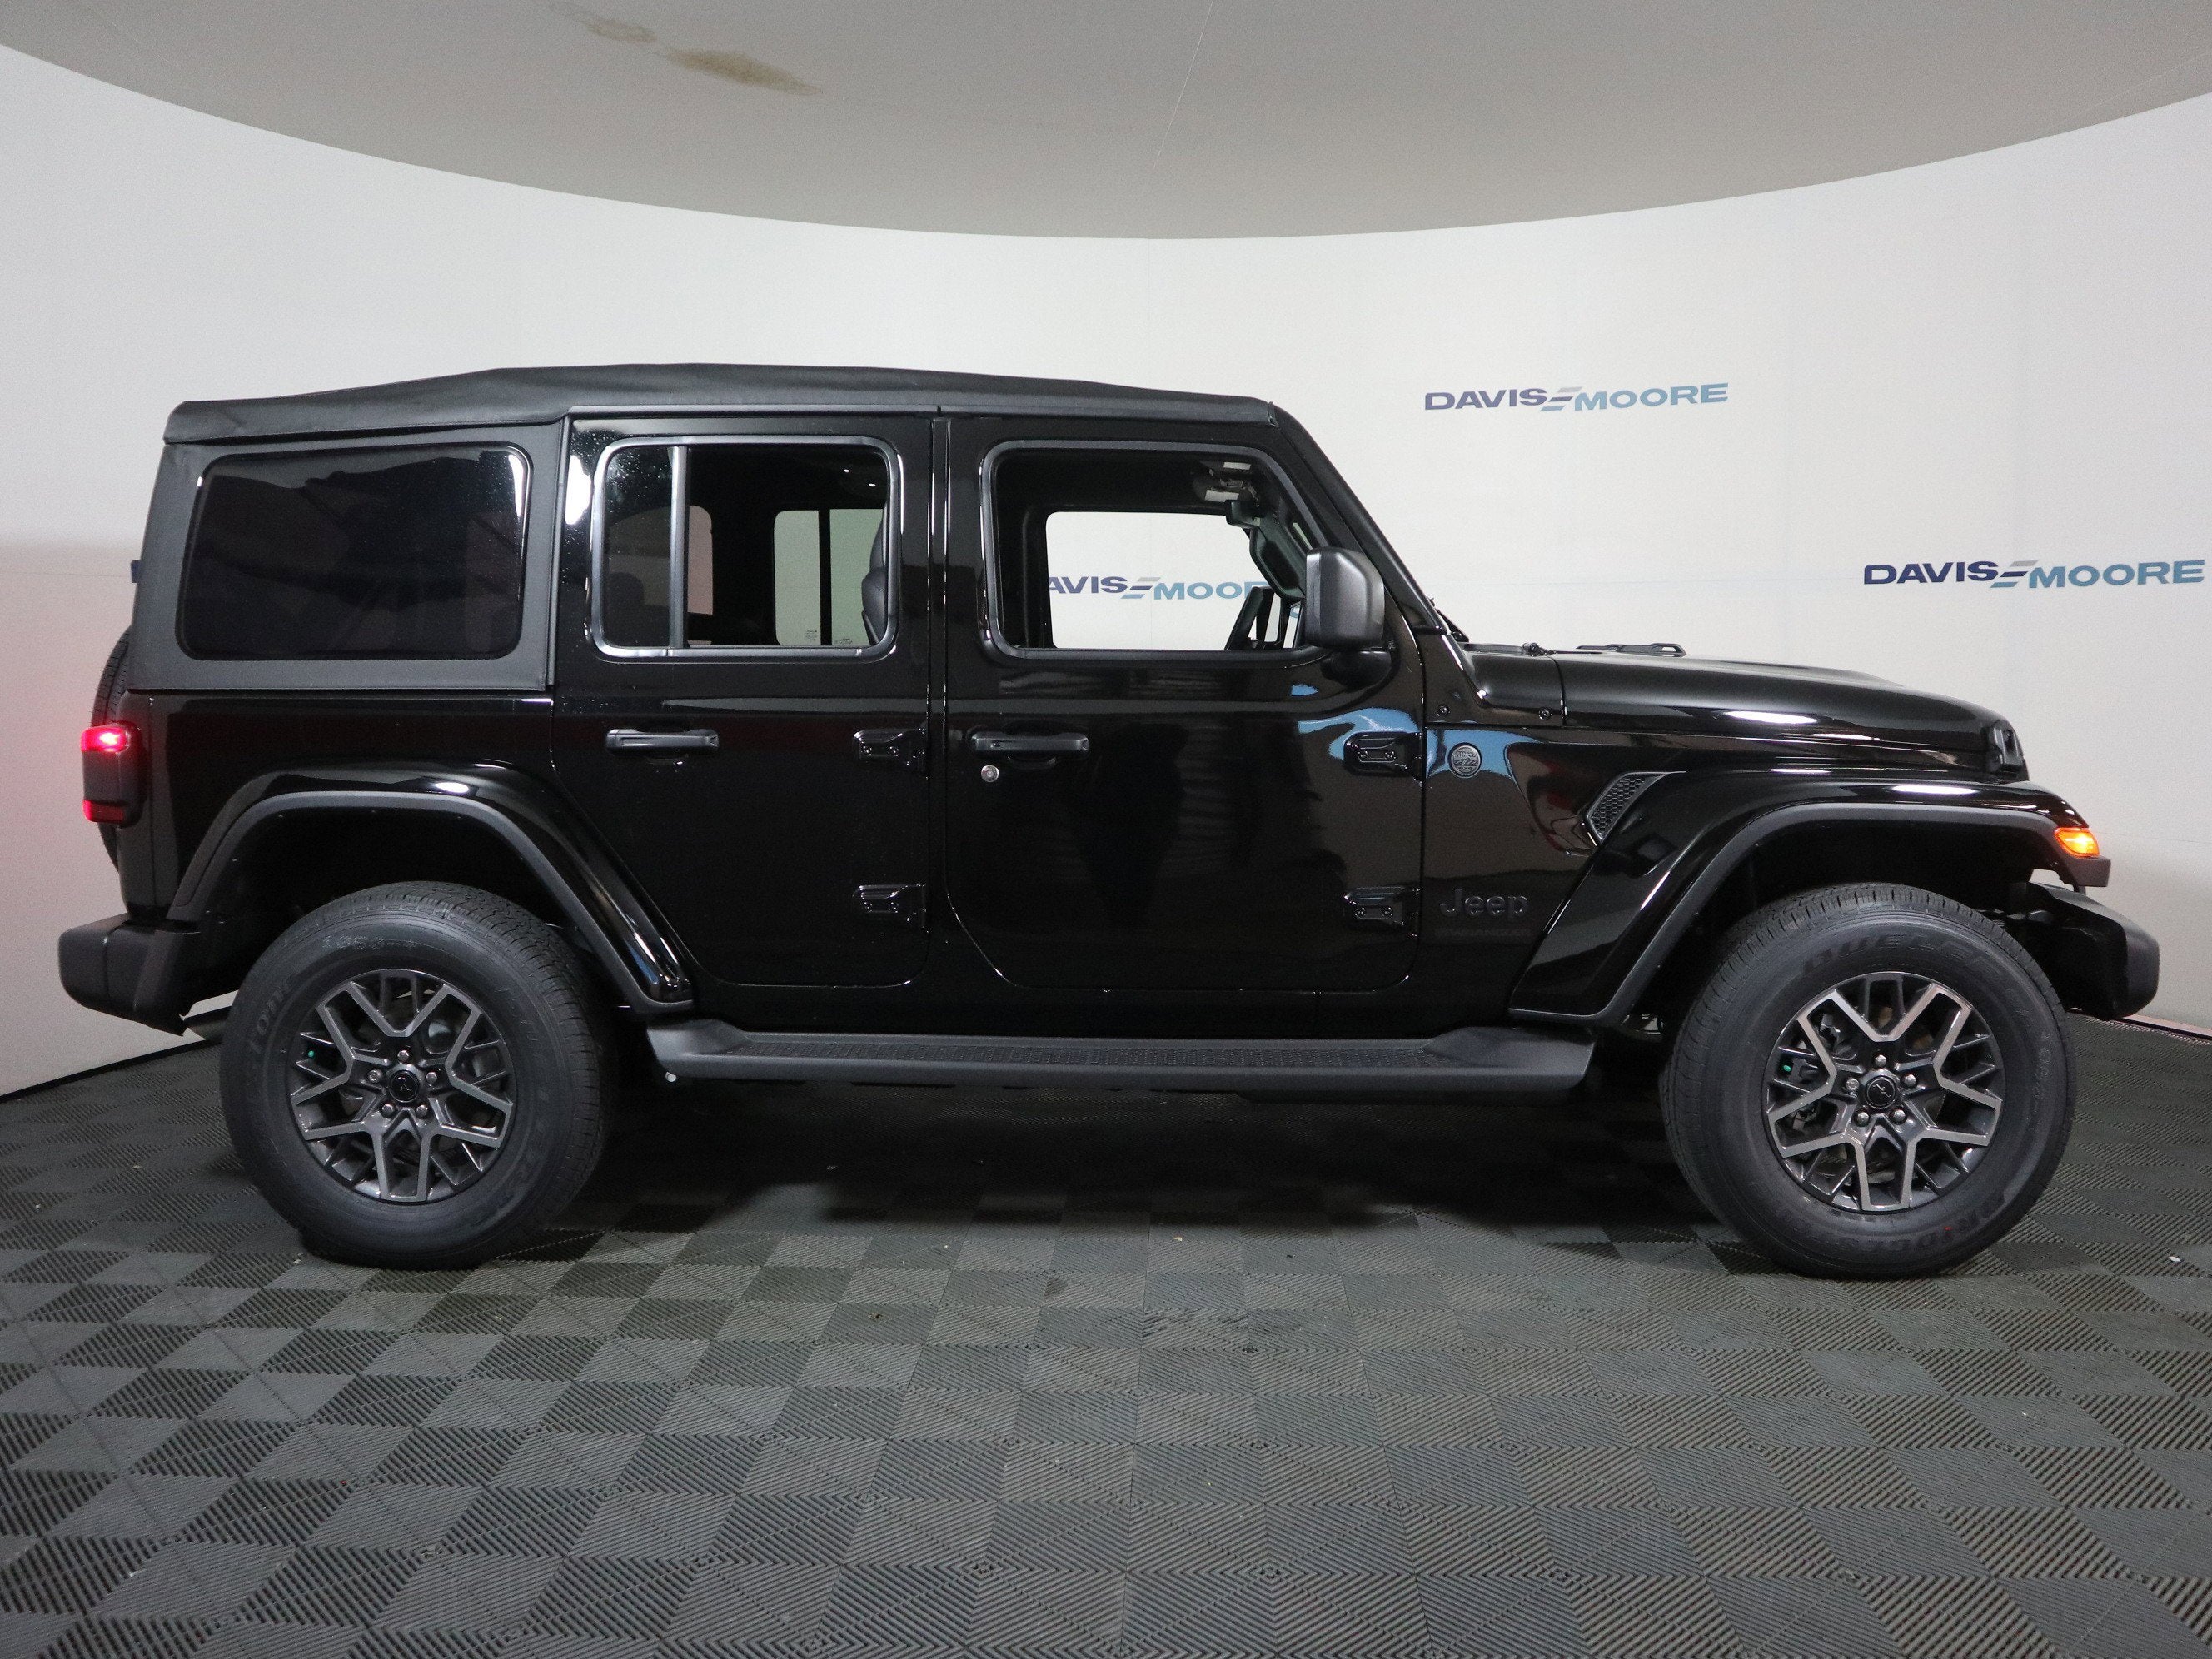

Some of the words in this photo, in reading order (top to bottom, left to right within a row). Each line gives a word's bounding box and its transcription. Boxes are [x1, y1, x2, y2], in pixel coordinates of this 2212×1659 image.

[1425, 388, 1547, 410] DAVIS
[1575, 383, 1728, 411] MOORE
[1049, 576, 1127, 594] AVIS
[1154, 581, 1268, 600] MOO
[1864, 560, 1999, 585] DAVIS
[2029, 560, 2205, 588] MOORE
[1439, 888, 1528, 920] Jeep
